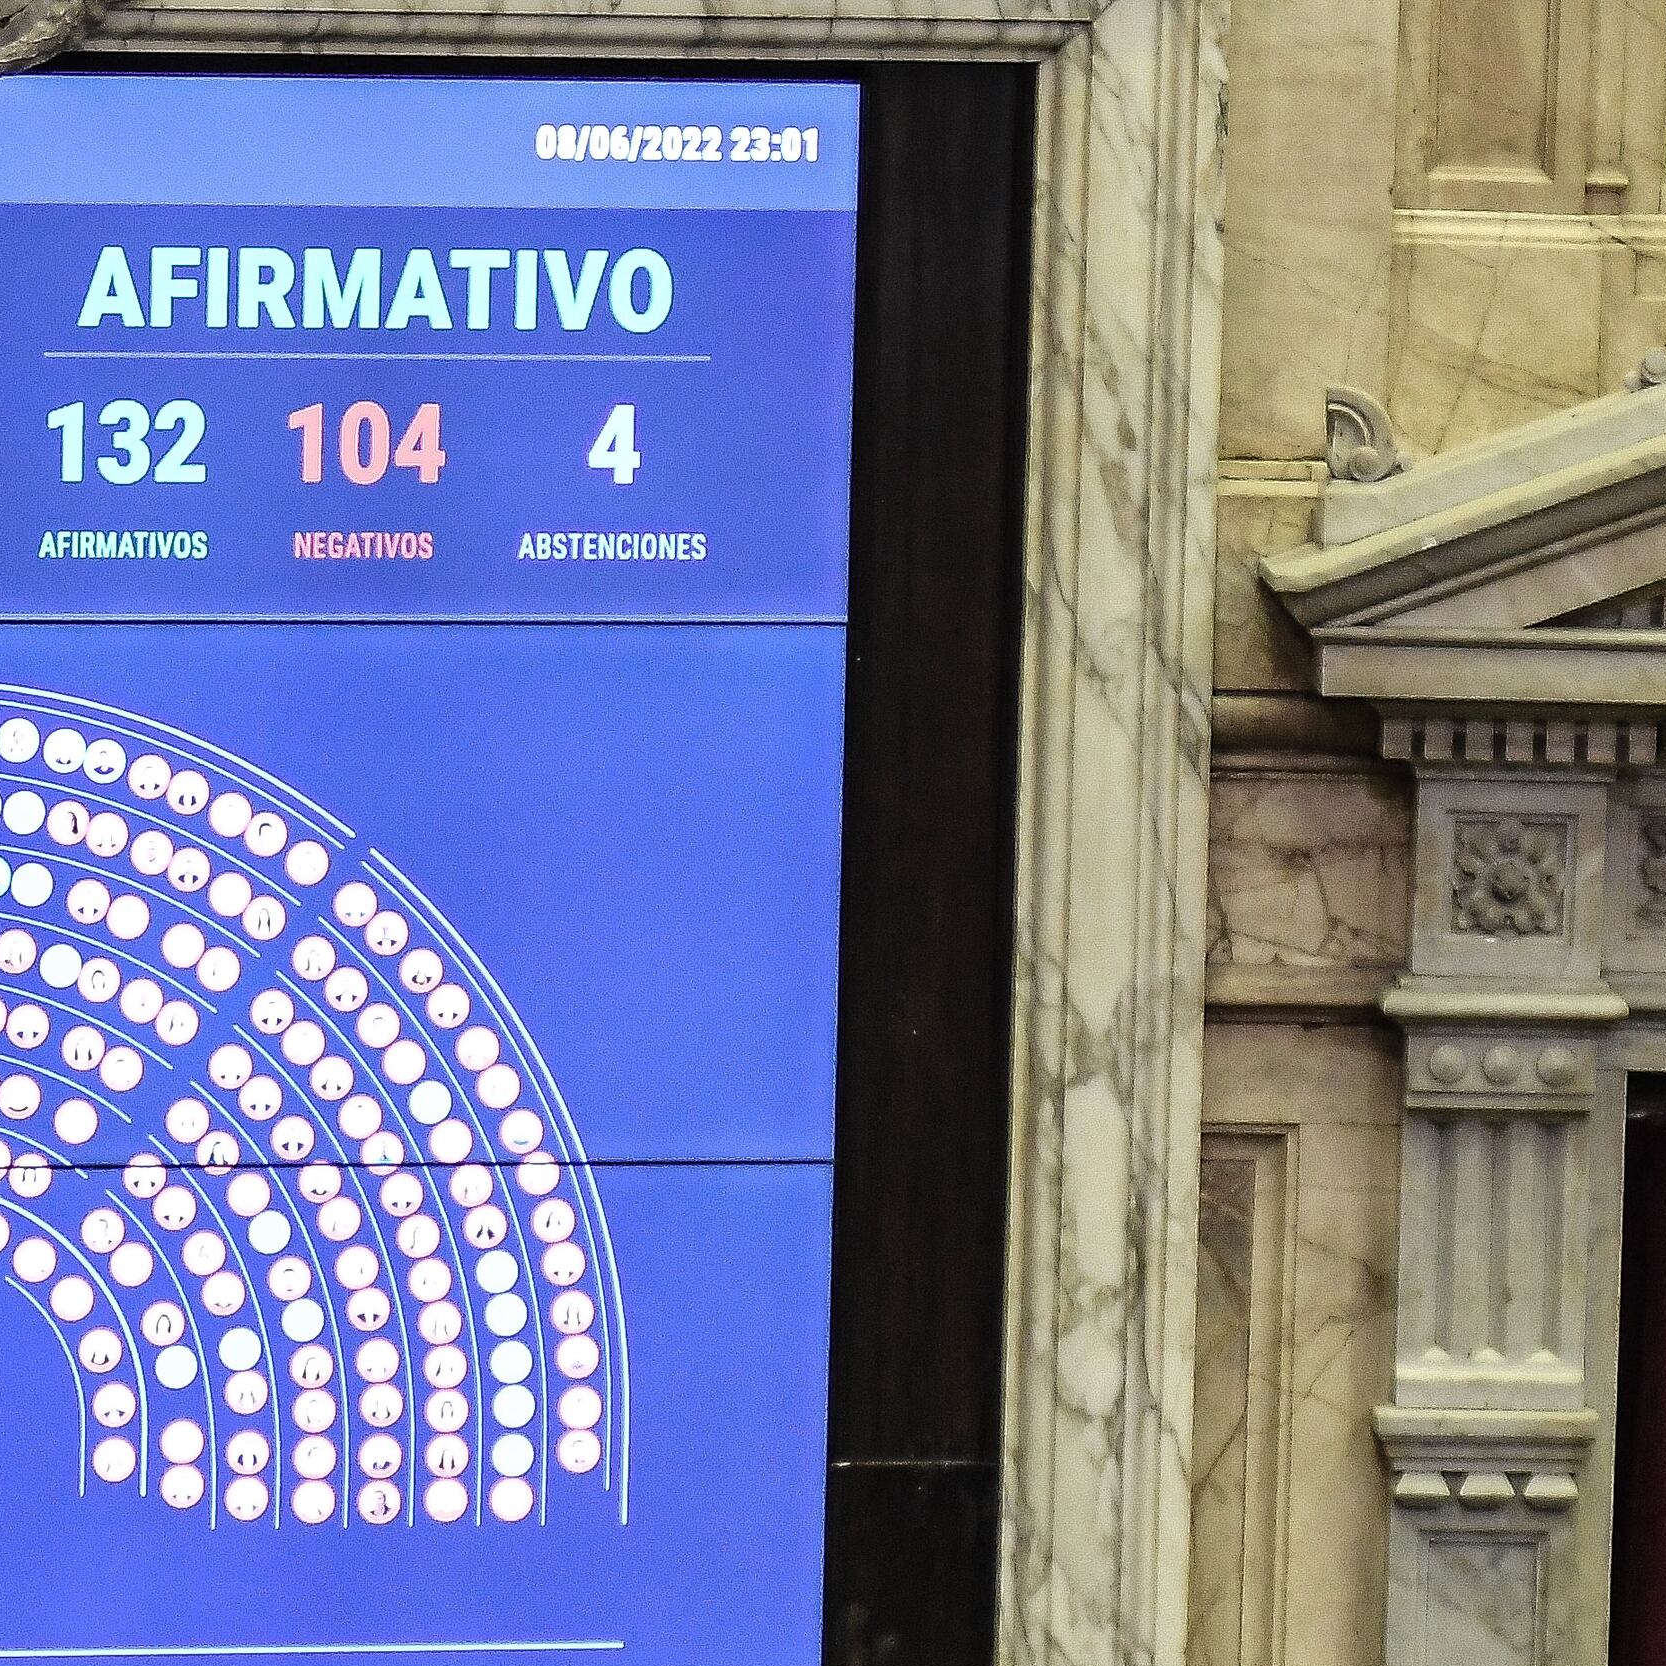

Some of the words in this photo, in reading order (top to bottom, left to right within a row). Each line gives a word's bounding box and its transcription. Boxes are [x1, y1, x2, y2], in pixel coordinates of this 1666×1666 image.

[535, 124, 724, 163] 08/06/2022
[731, 126, 820, 163] 23:01
[77, 246, 674, 334] AFIRMATIVO
[46, 399, 207, 486] 132
[284, 401, 448, 487] 104
[587, 404, 642, 486] 4
[38, 530, 209, 561] AFIRMATIVOS
[292, 530, 435, 562] NEGATIVOS
[517, 532, 708, 562] ABSTENCIONES
